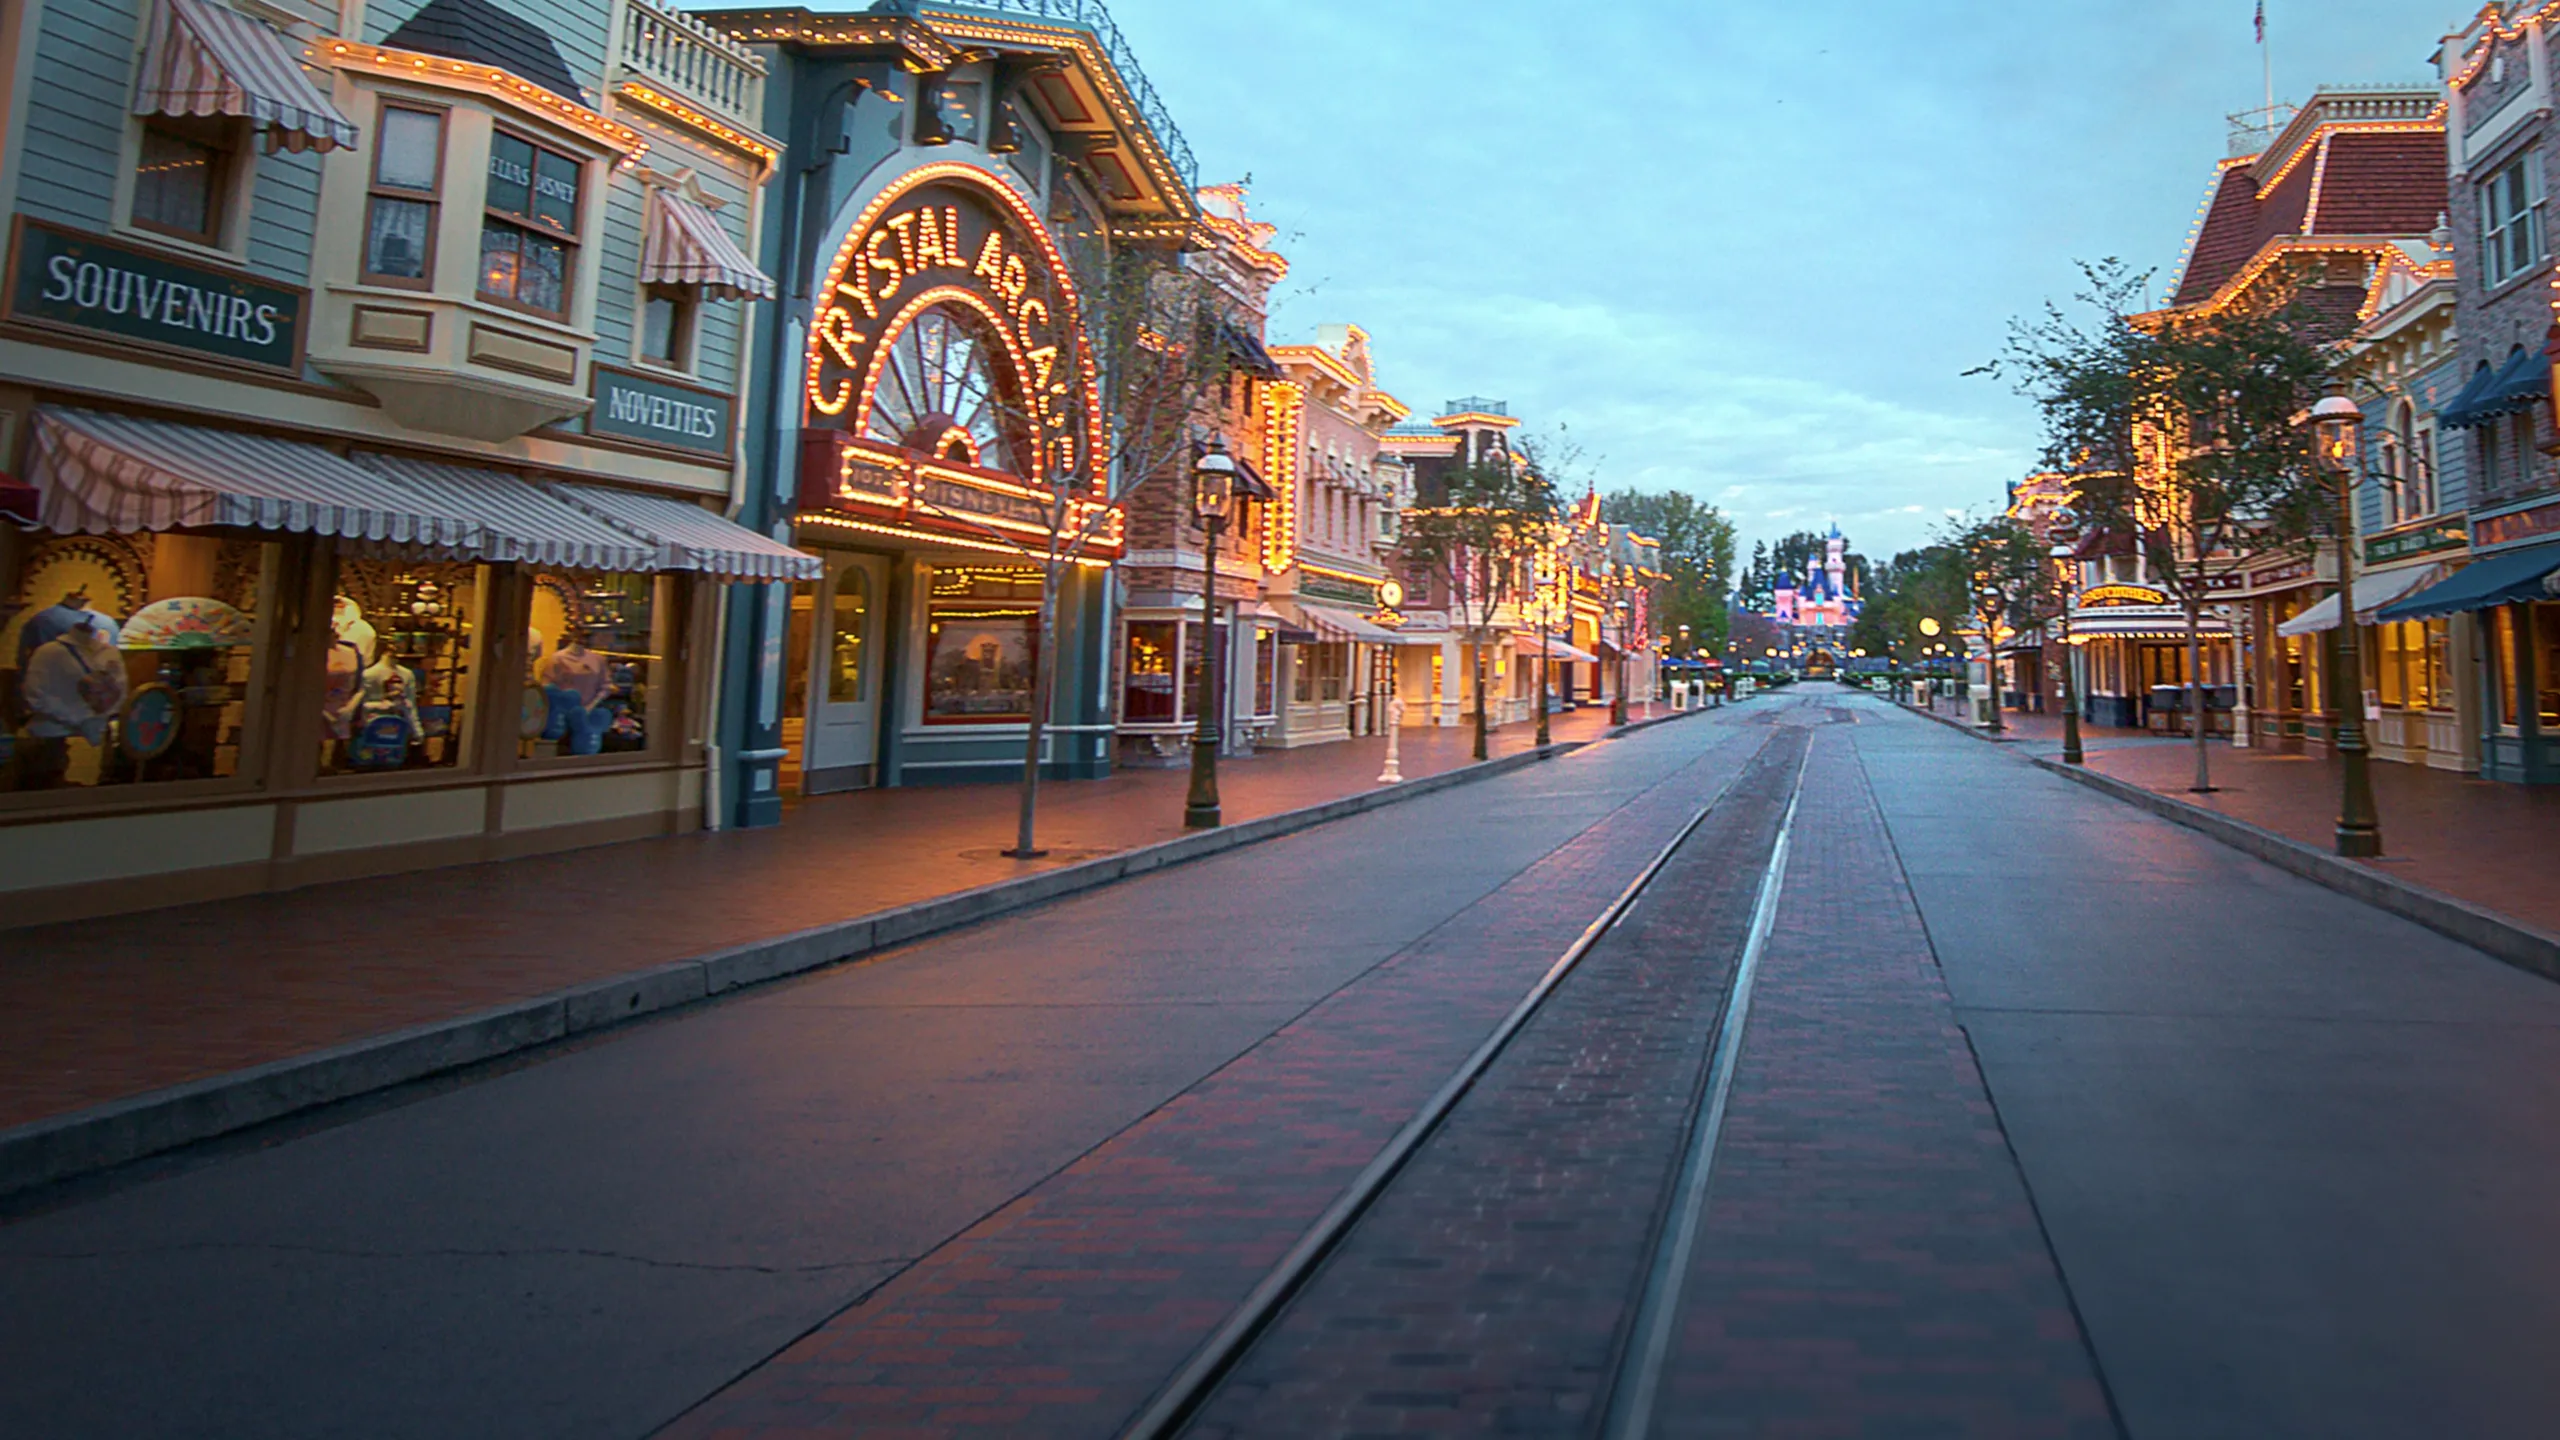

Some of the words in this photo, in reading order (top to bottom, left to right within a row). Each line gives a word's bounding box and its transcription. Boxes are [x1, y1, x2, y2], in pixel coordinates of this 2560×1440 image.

[490, 156, 531, 187] ELIAS
[534, 172, 577, 204] DISNEY
[43, 255, 279, 345] SOUVENIRS
[805, 205, 968, 415] CRYSTAL
[973, 231, 1075, 472] ARCADE
[608, 386, 717, 438] NOVELTIES
